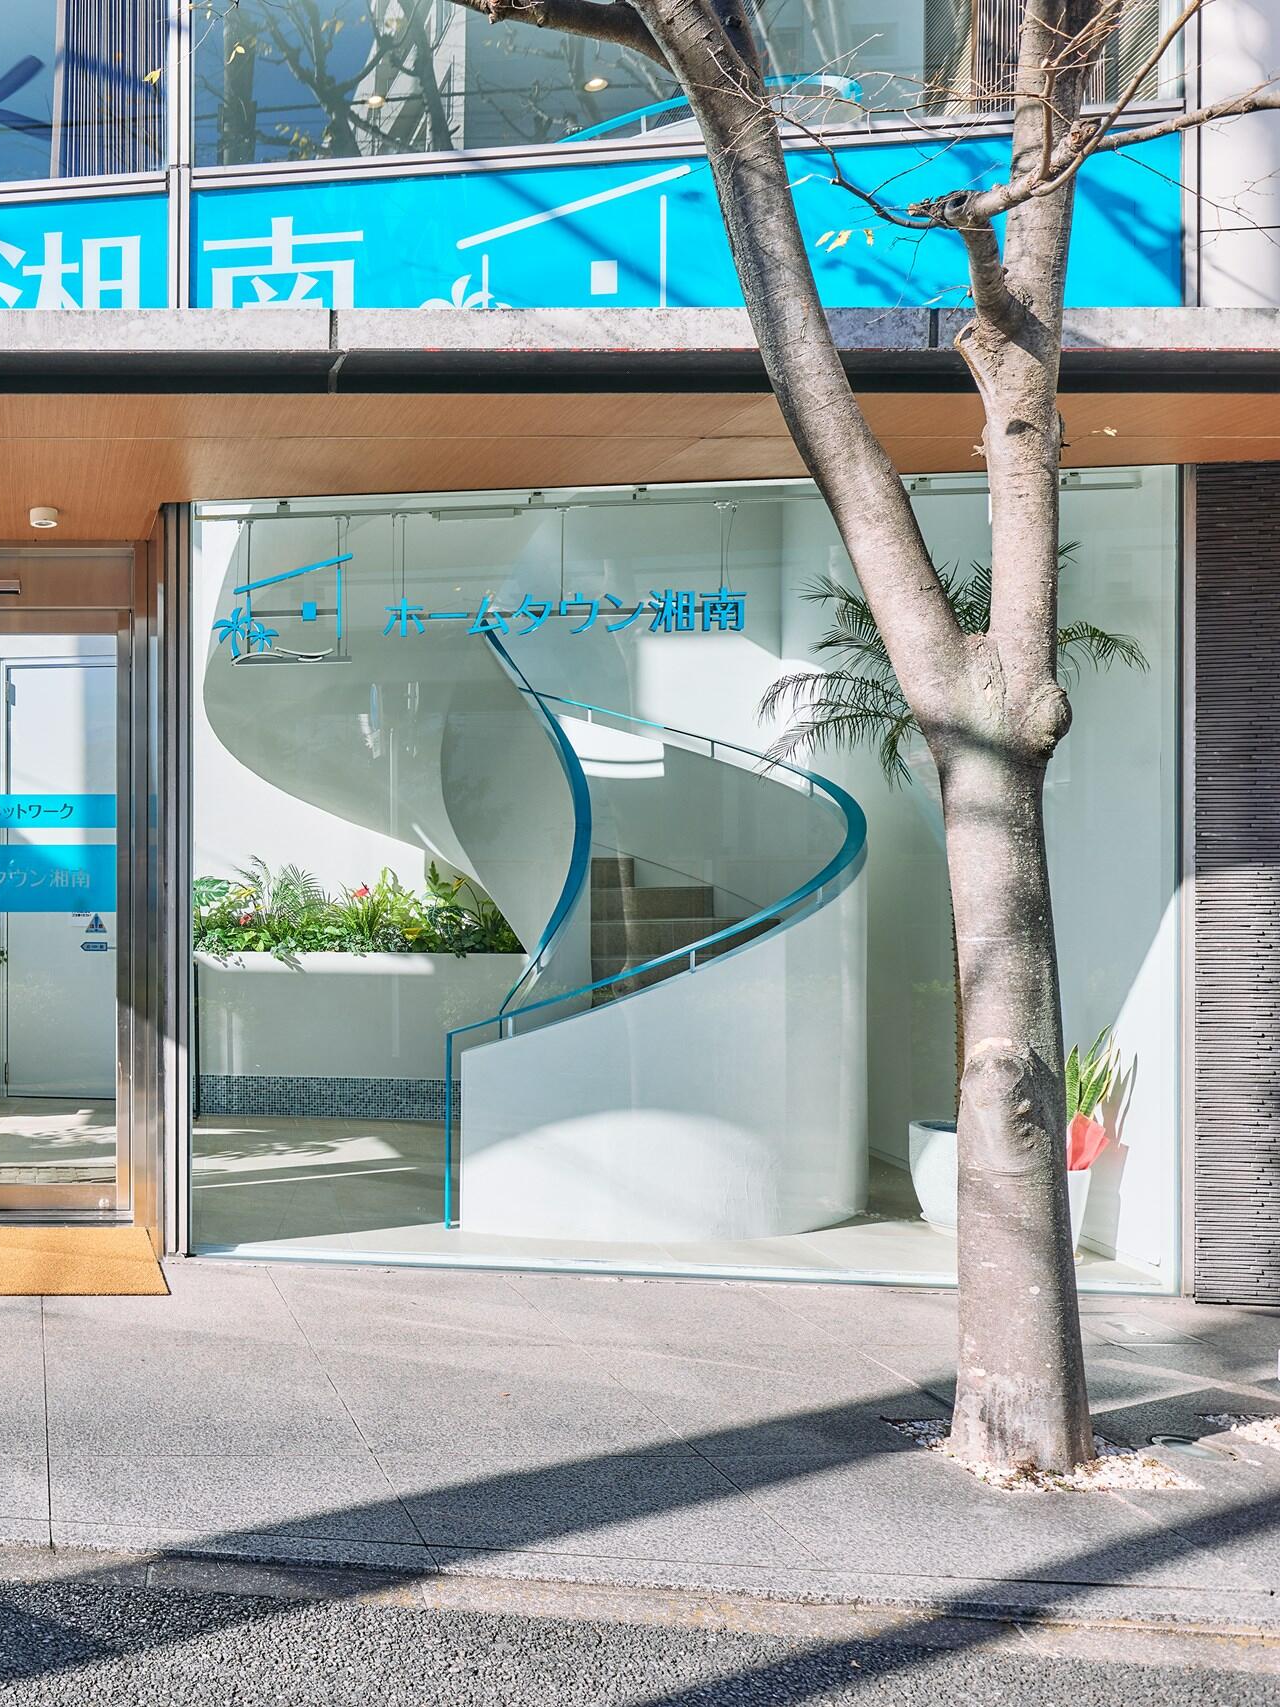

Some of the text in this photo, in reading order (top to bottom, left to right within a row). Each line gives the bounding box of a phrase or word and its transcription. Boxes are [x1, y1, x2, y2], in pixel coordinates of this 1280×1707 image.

[382, 587, 748, 638] ホームタウン湘南
